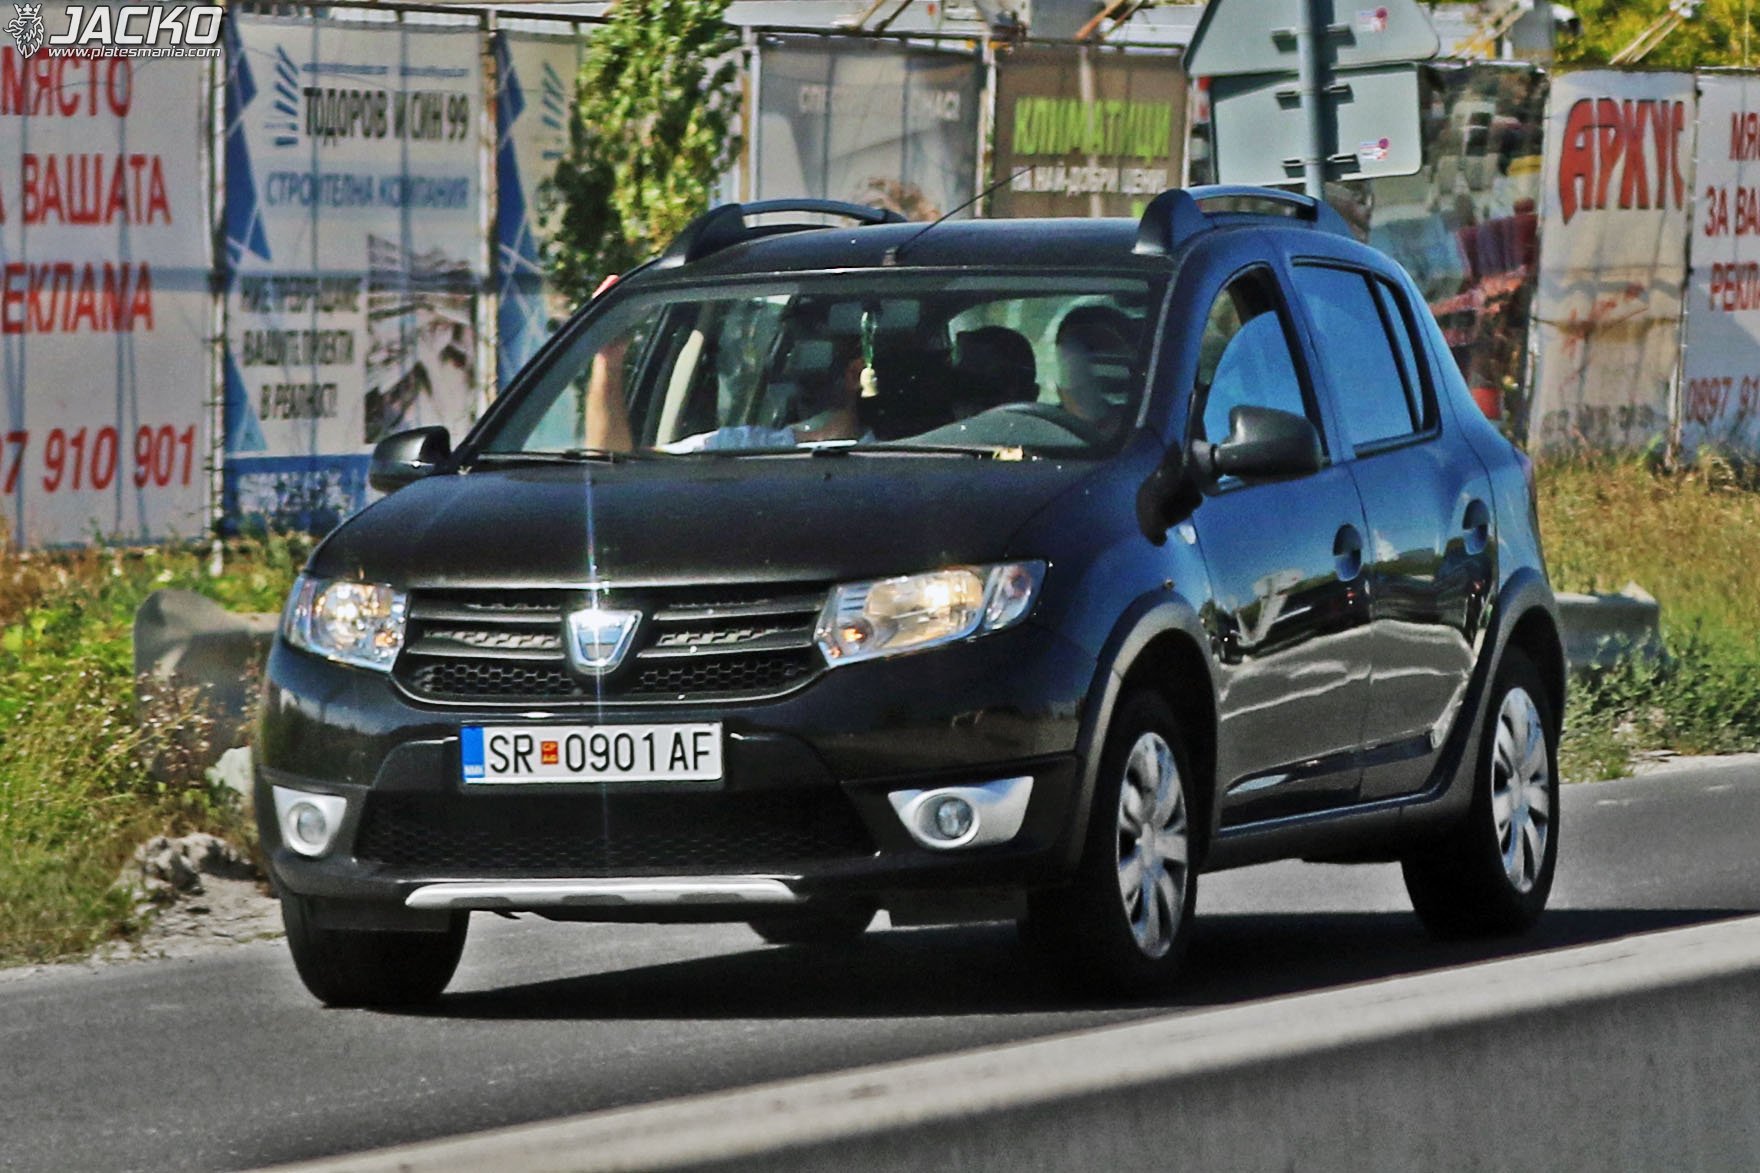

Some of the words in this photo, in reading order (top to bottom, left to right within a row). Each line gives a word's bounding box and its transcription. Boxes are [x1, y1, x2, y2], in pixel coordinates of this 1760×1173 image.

[1559, 97, 1684, 226] АРКУС
[1729, 111, 1760, 161] МЯ
[22, 154, 172, 225] ВАШАТА
[43, 425, 119, 493] 910
[133, 423, 196, 489] 901
[489, 734, 534, 773] SR
